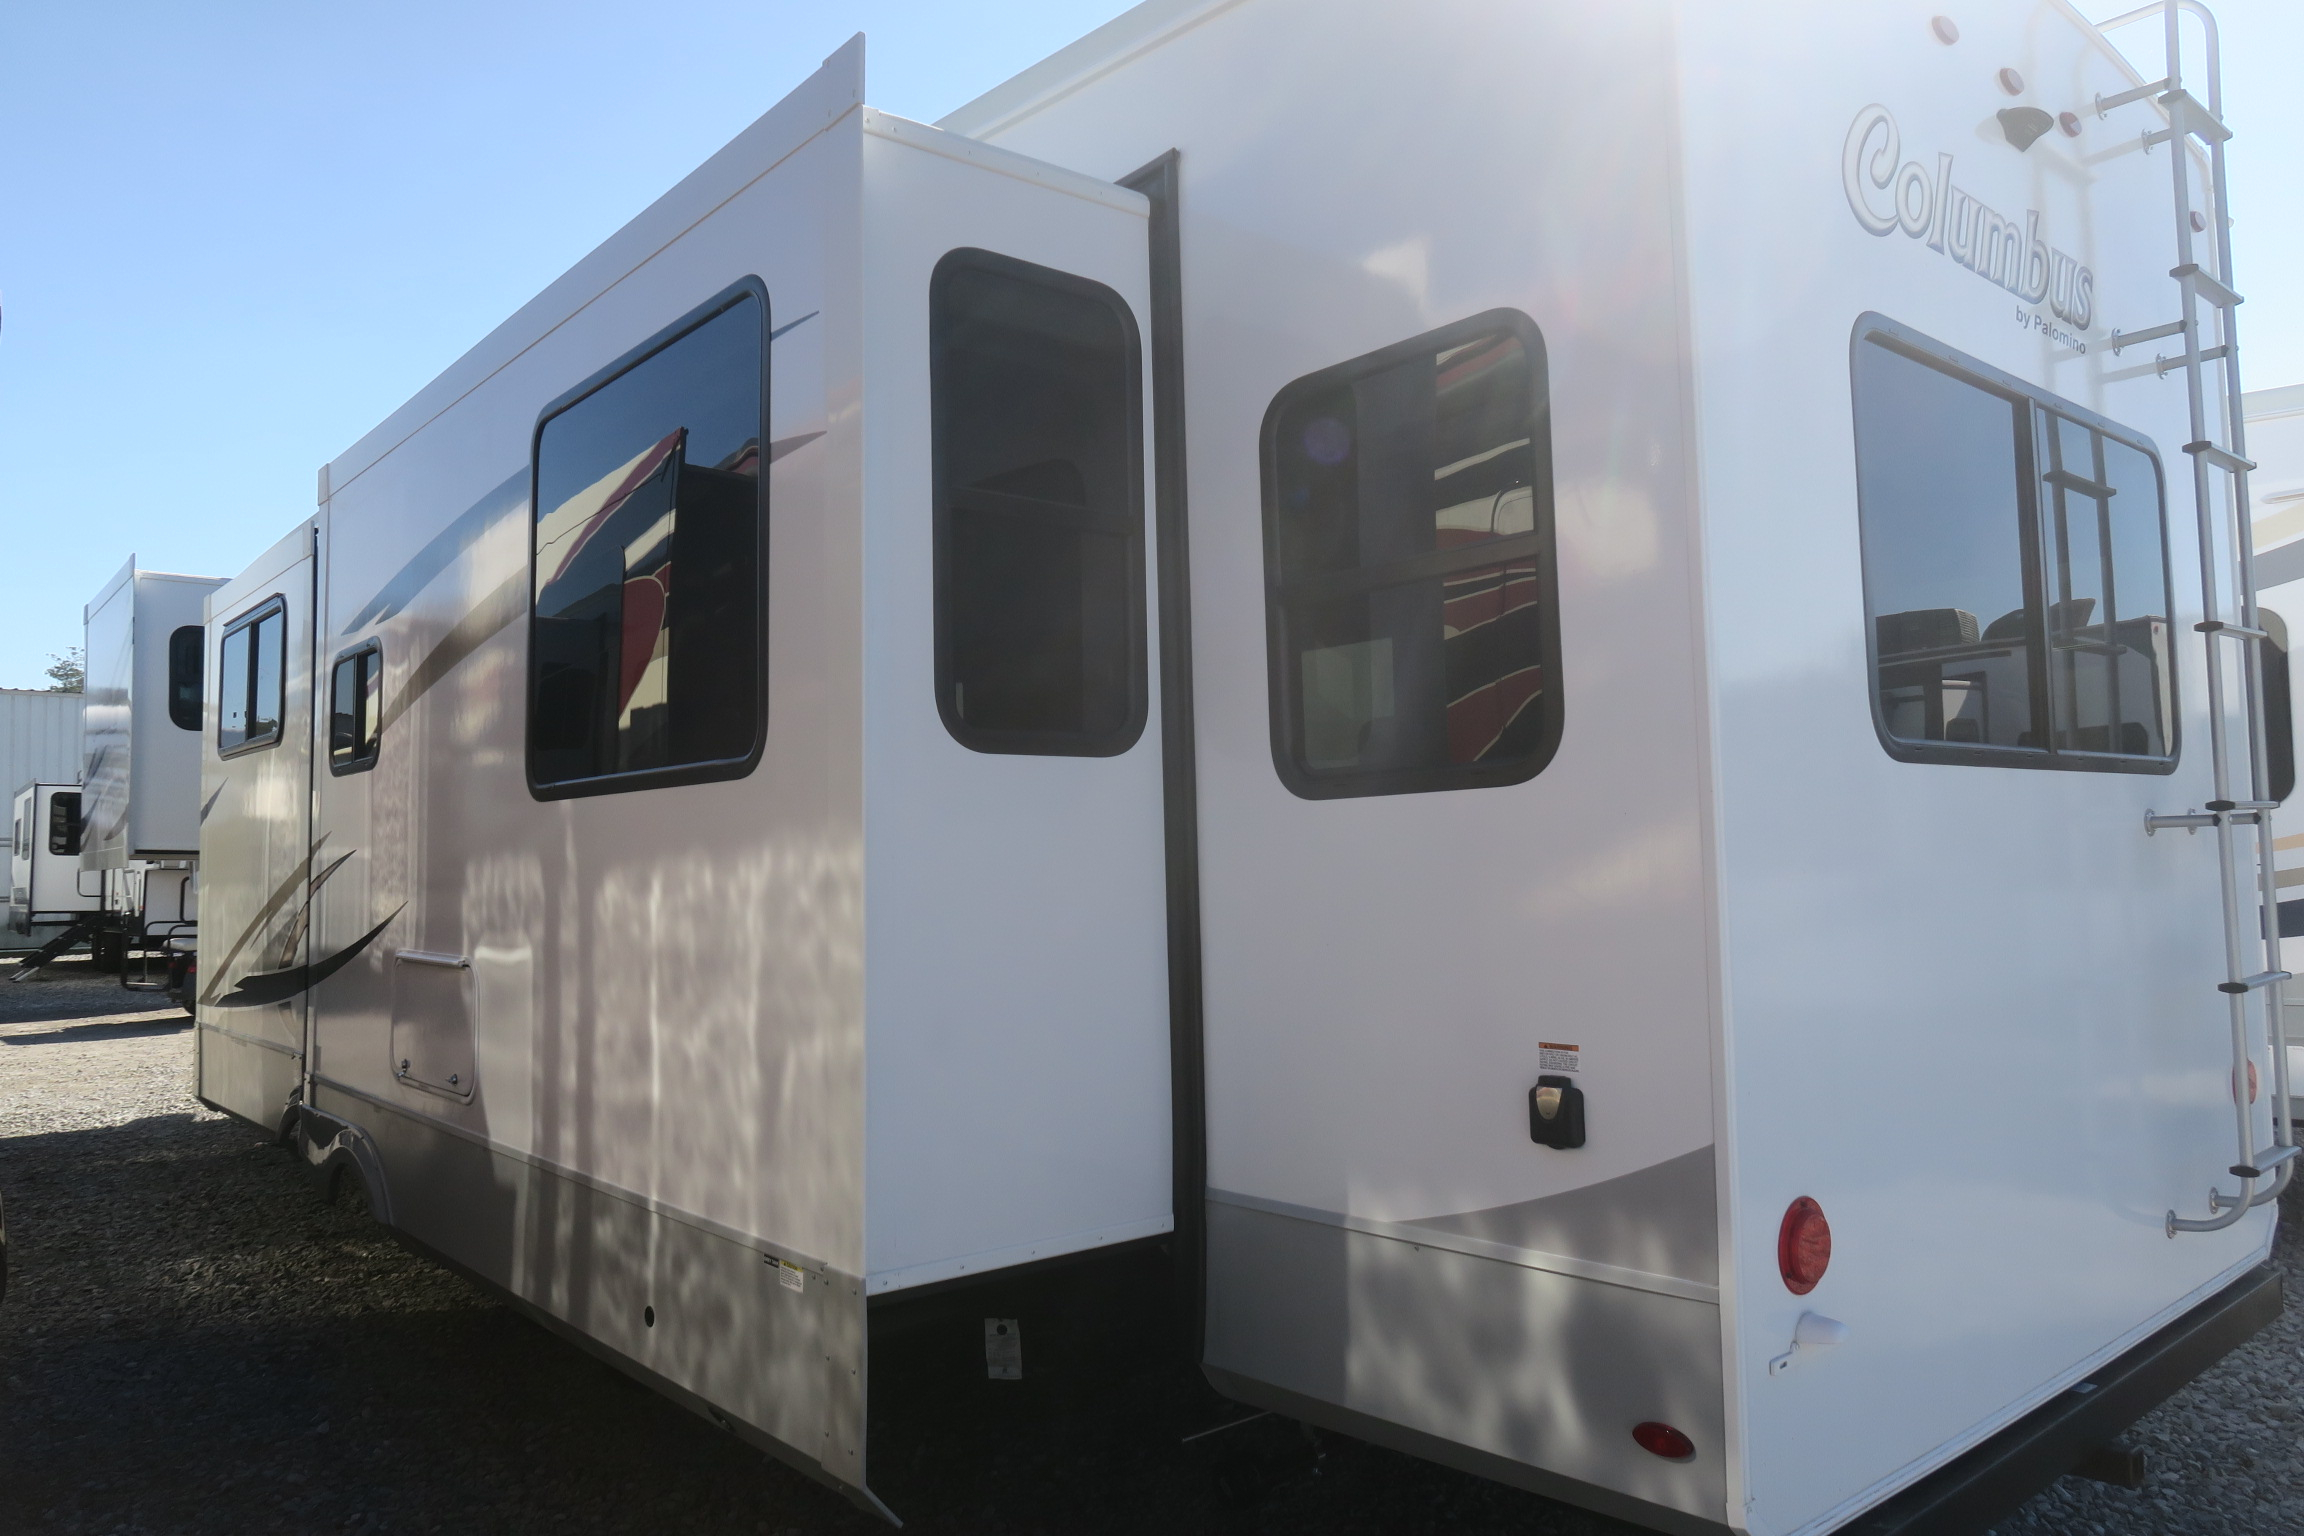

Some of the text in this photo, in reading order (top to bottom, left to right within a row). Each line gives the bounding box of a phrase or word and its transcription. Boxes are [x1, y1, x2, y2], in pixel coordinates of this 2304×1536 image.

[1842, 103, 2093, 331] Columbus
[2016, 305, 2086, 354] by Palomino
